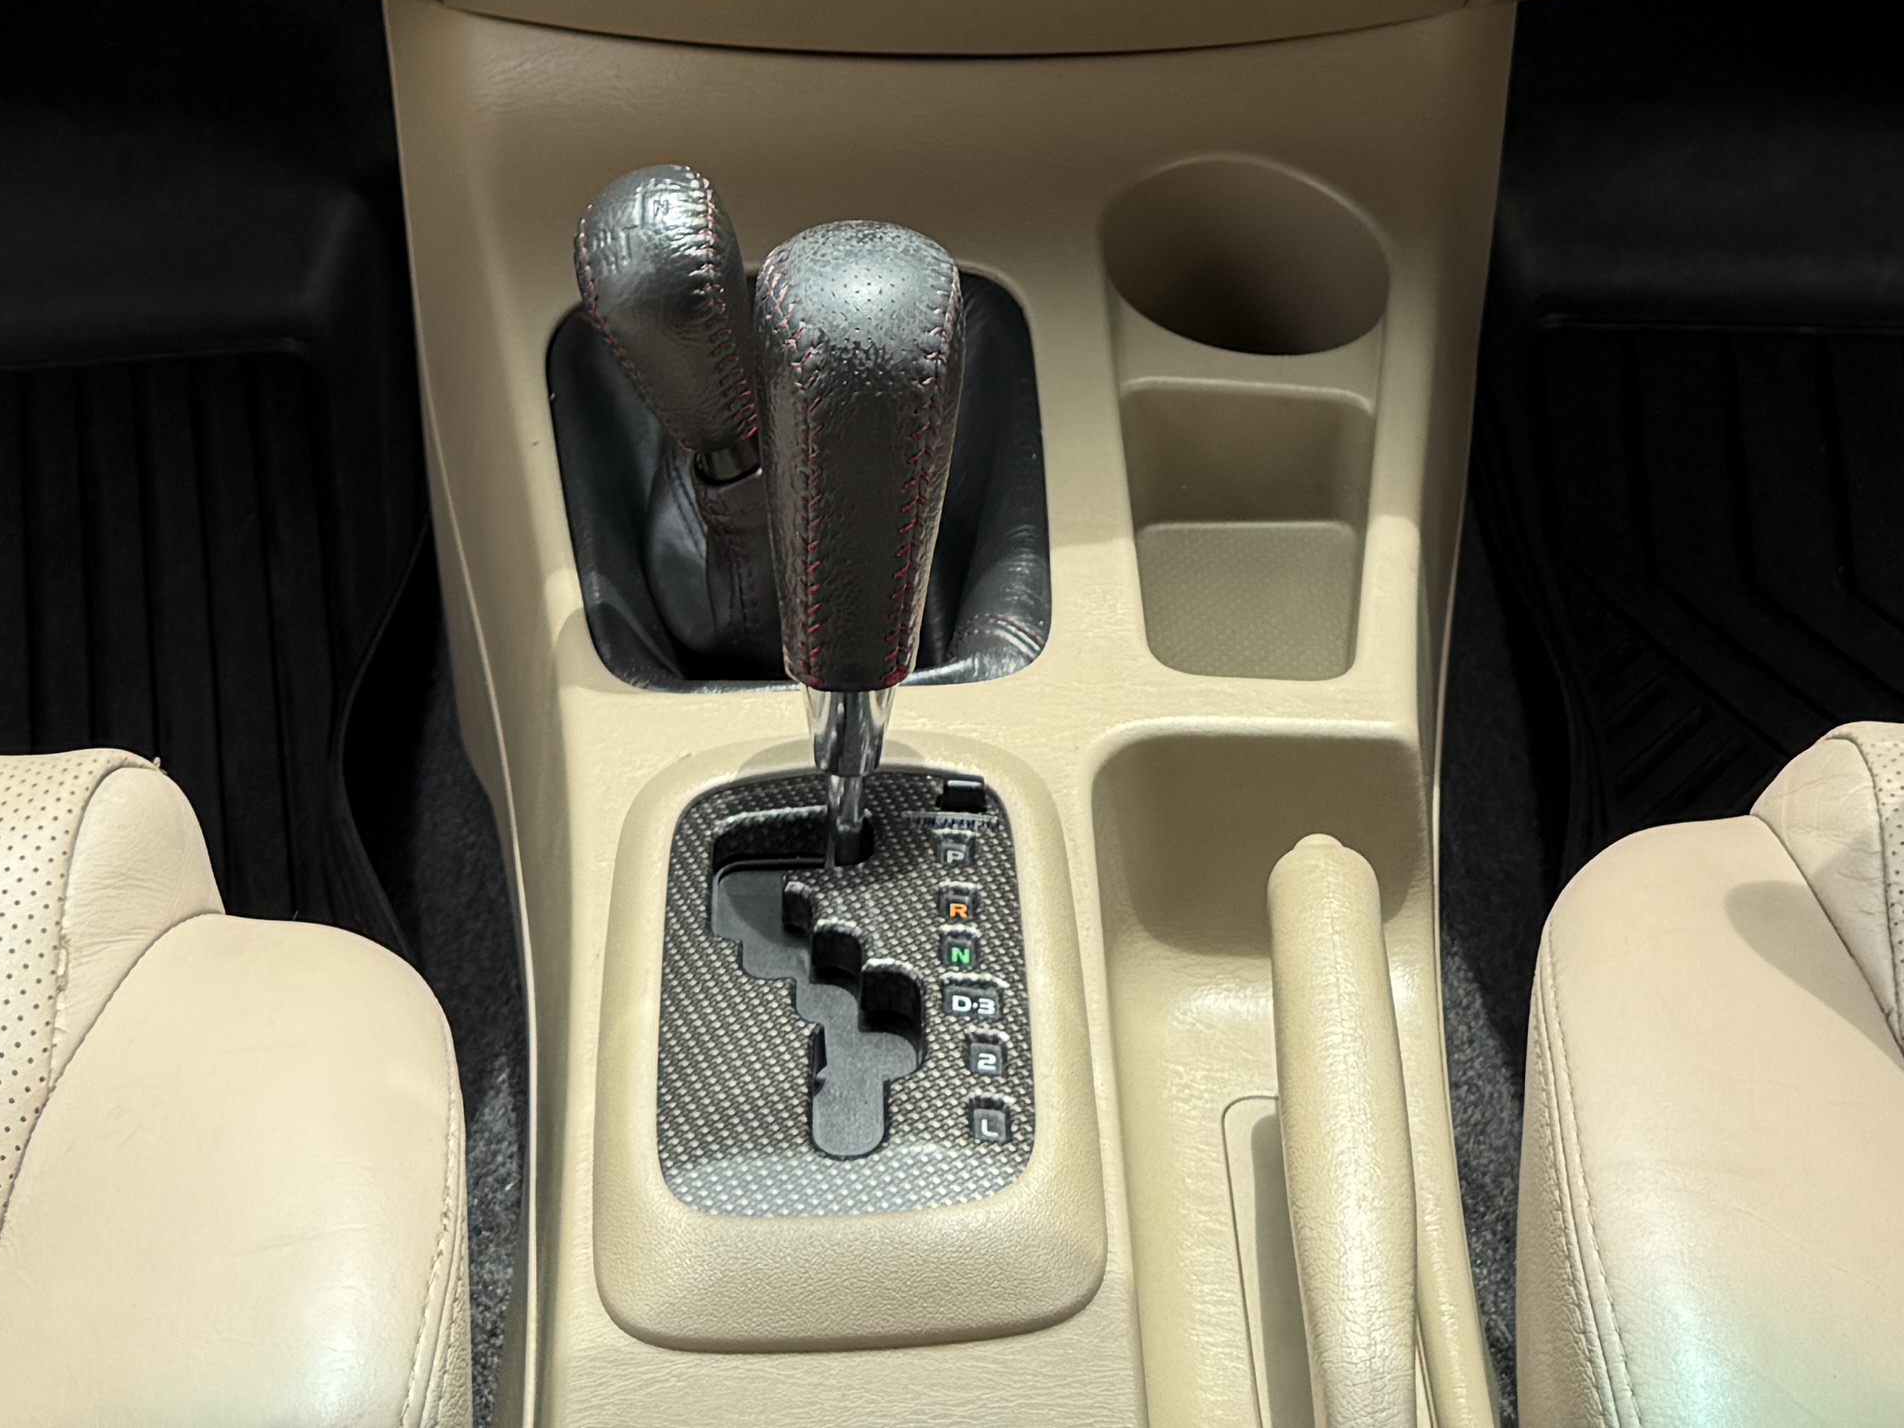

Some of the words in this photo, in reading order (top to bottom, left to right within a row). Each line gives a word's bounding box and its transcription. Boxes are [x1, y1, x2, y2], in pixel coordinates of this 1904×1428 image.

[947, 850, 965, 864] P
[950, 903, 968, 919] R
[951, 947, 971, 964] N
[978, 1053, 996, 1072] 2
[981, 1119, 999, 1138] L
